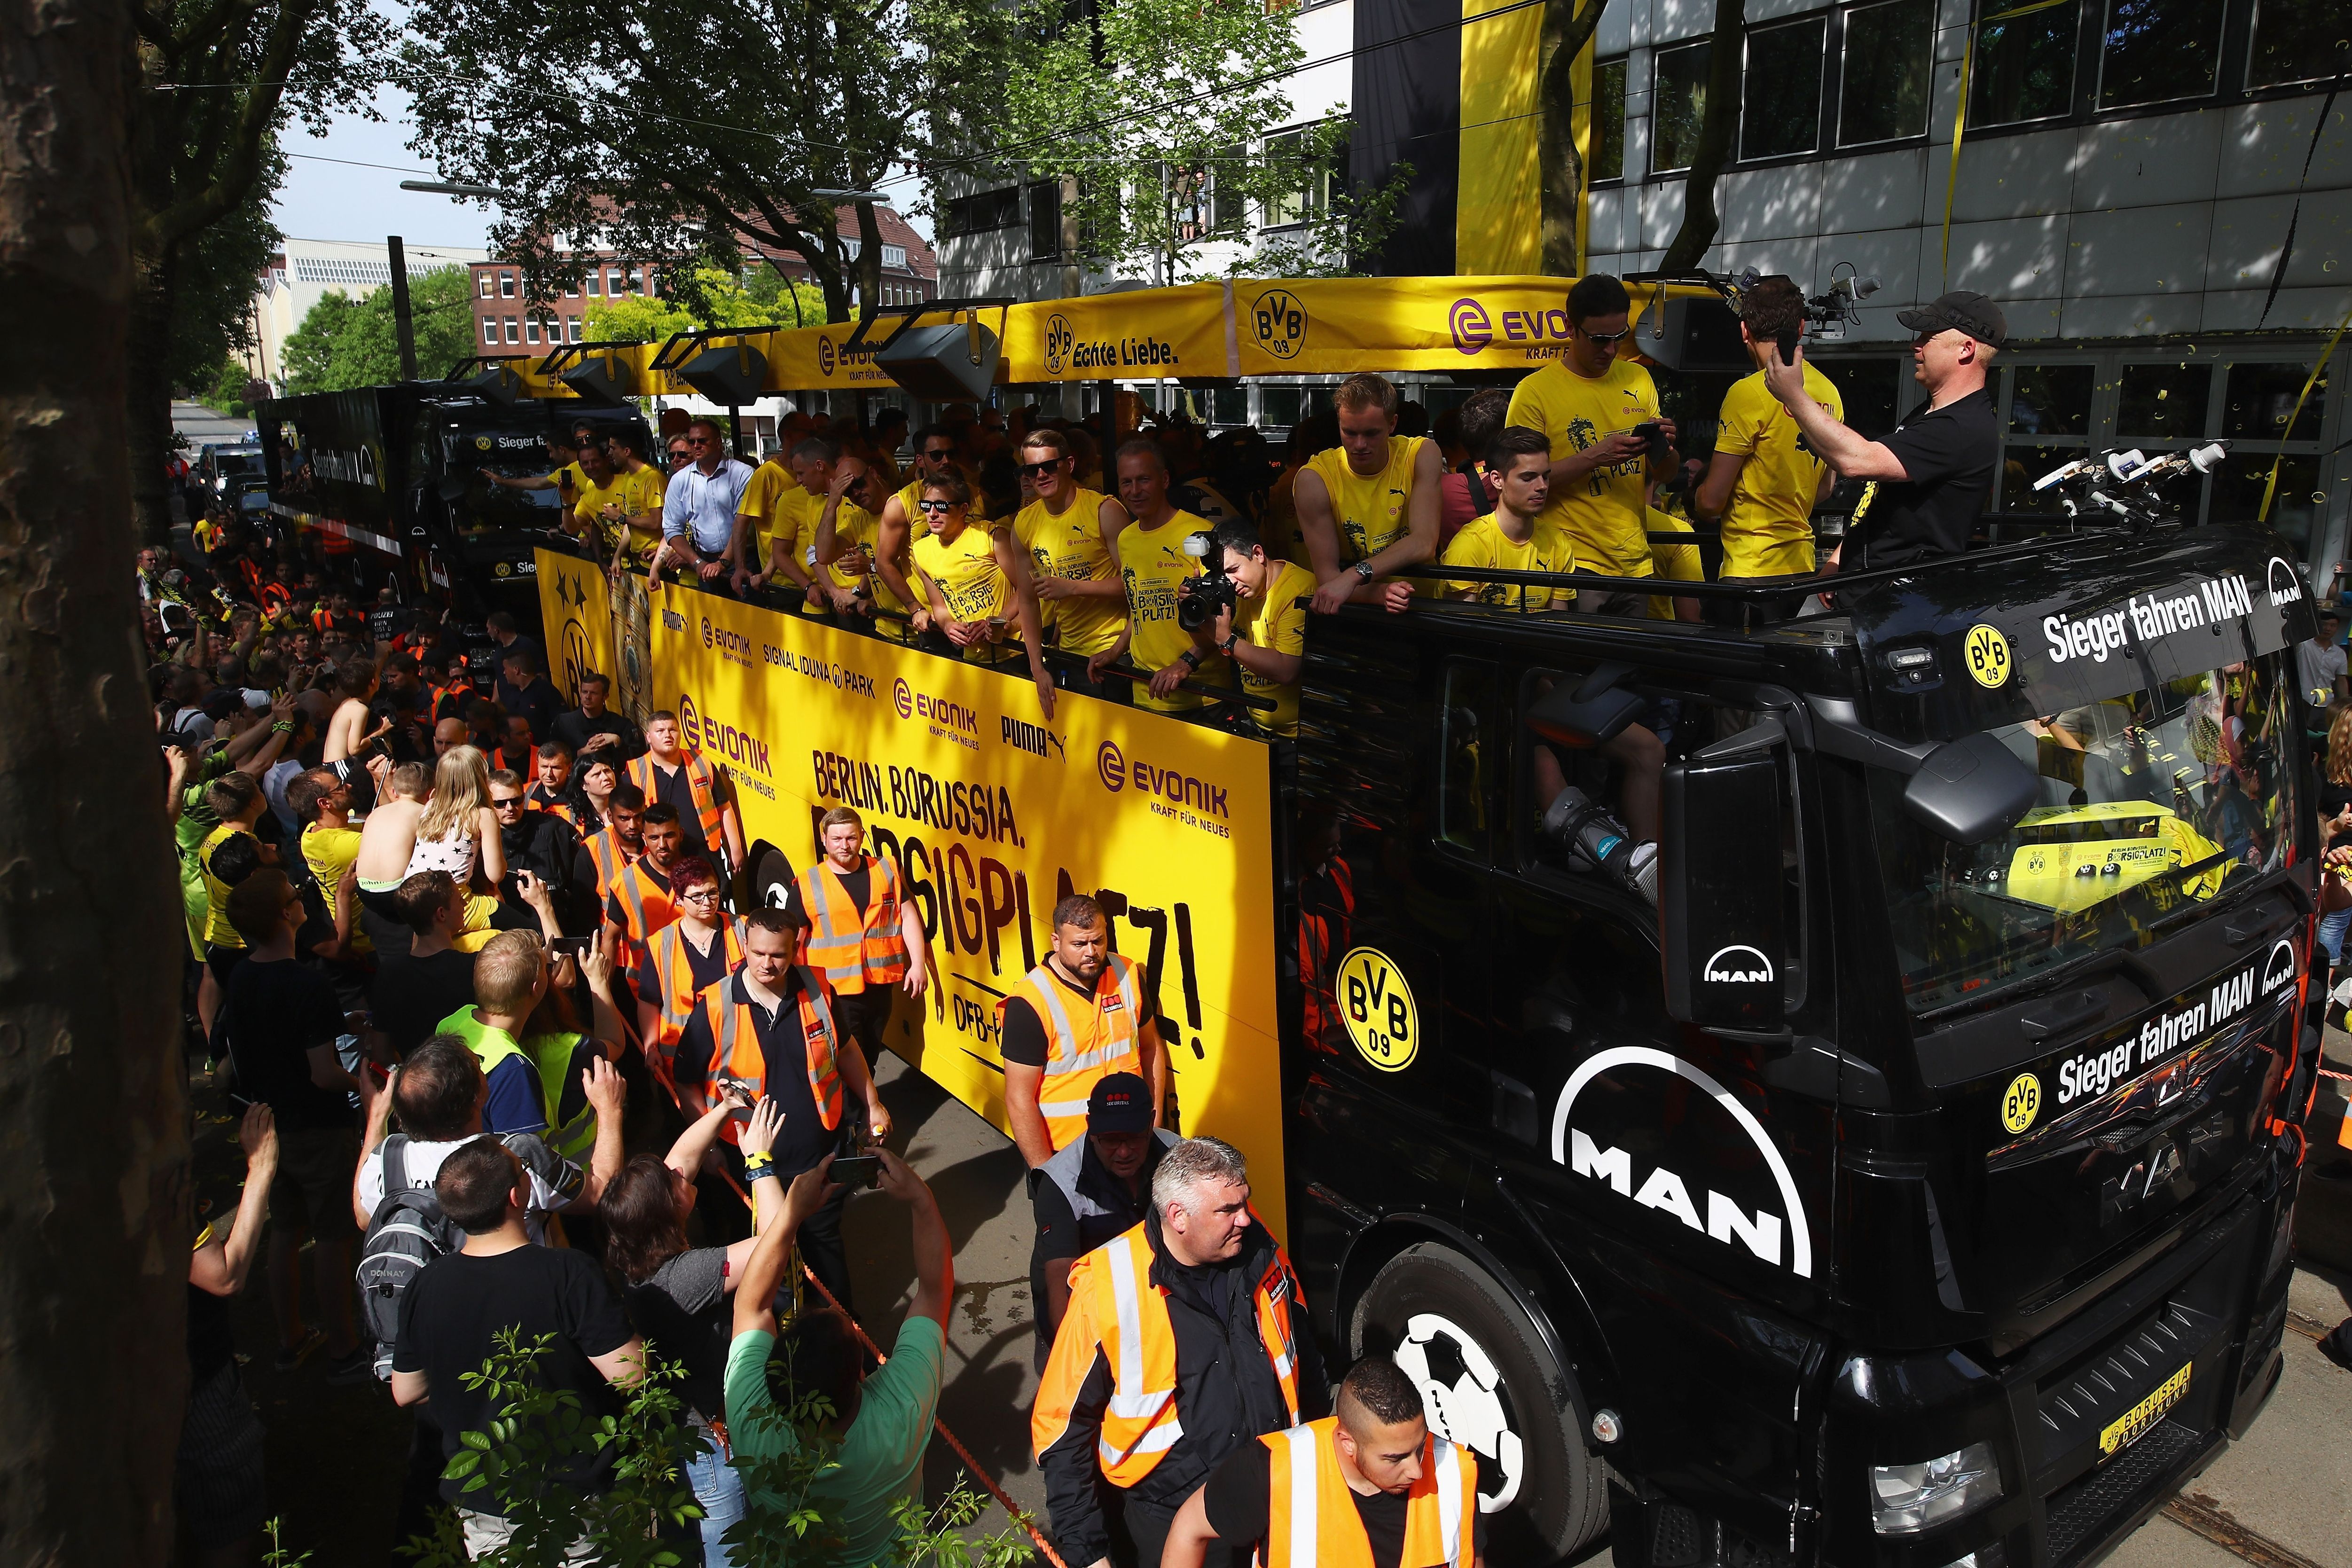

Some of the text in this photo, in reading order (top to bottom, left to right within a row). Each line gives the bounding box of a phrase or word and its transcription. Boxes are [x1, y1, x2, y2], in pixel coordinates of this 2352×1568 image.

[1257, 296, 1302, 340] BVB
[1503, 309, 1572, 340] EVO
[1944, 308, 1994, 340] MAN
[1048, 320, 1072, 357] BVB
[1073, 337, 1179, 368] Echte Liebe.
[1274, 340, 1289, 353] 09
[1051, 357, 1059, 368] 09
[1526, 347, 1561, 360] KRAFT
[849, 368, 891, 381] KRAFT FÜR NEUE
[477, 437, 490, 447] BVB
[498, 437, 534, 449] Sieger
[432, 571, 447, 588] MAN
[517, 562, 537, 573] Sie
[965, 594, 995, 616] PLATZ!
[2273, 586, 2301, 605] MAN
[662, 608, 682, 633] PUMA
[1142, 606, 1175, 622] PLATZ!
[2044, 575, 2252, 663] Sieger fahren MAN
[715, 627, 752, 657] EVONIK
[1972, 633, 2006, 671] BVB
[723, 652, 734, 661] KRAFT
[742, 657, 753, 669] NEUES
[763, 643, 876, 699] SIGNAL IDUNA PARK
[1986, 669, 1999, 681] 09
[917, 693, 978, 735] EVONIK
[704, 716, 773, 778] EVONIK
[929, 724, 980, 751] KRAFT FÜR NEUES
[1001, 714, 1047, 759] PUMA
[720, 762, 776, 801] KRAFT FÜR NEUES
[1133, 760, 1230, 819] EVONIK
[813, 750, 1026, 849] BERLIN. BORUSSIA.
[1150, 801, 1230, 839] KRAFT FÜR NEUES
[1599, 838, 1617, 854] VACOped
[2030, 858, 2043, 869] BVB
[1710, 971, 1767, 982] MAN
[2265, 965, 2292, 993] MAN
[1348, 959, 1408, 1041] BVB
[954, 993, 1001, 1048] DFB-P
[1369, 1028, 1390, 1057] 09
[2059, 967, 2254, 1104] Sieger fahren MAN
[2008, 1080, 2037, 1119] BVB
[2015, 1113, 2026, 1127] 09
[1572, 1128, 1781, 1266] MAN
[1271, 1279, 1285, 1299] SECURITAS
[2123, 1382, 2187, 1443] DORTMUND
[2125, 1367, 2188, 1429] BORUSSIA
[2107, 1431, 2119, 1447] BVB
